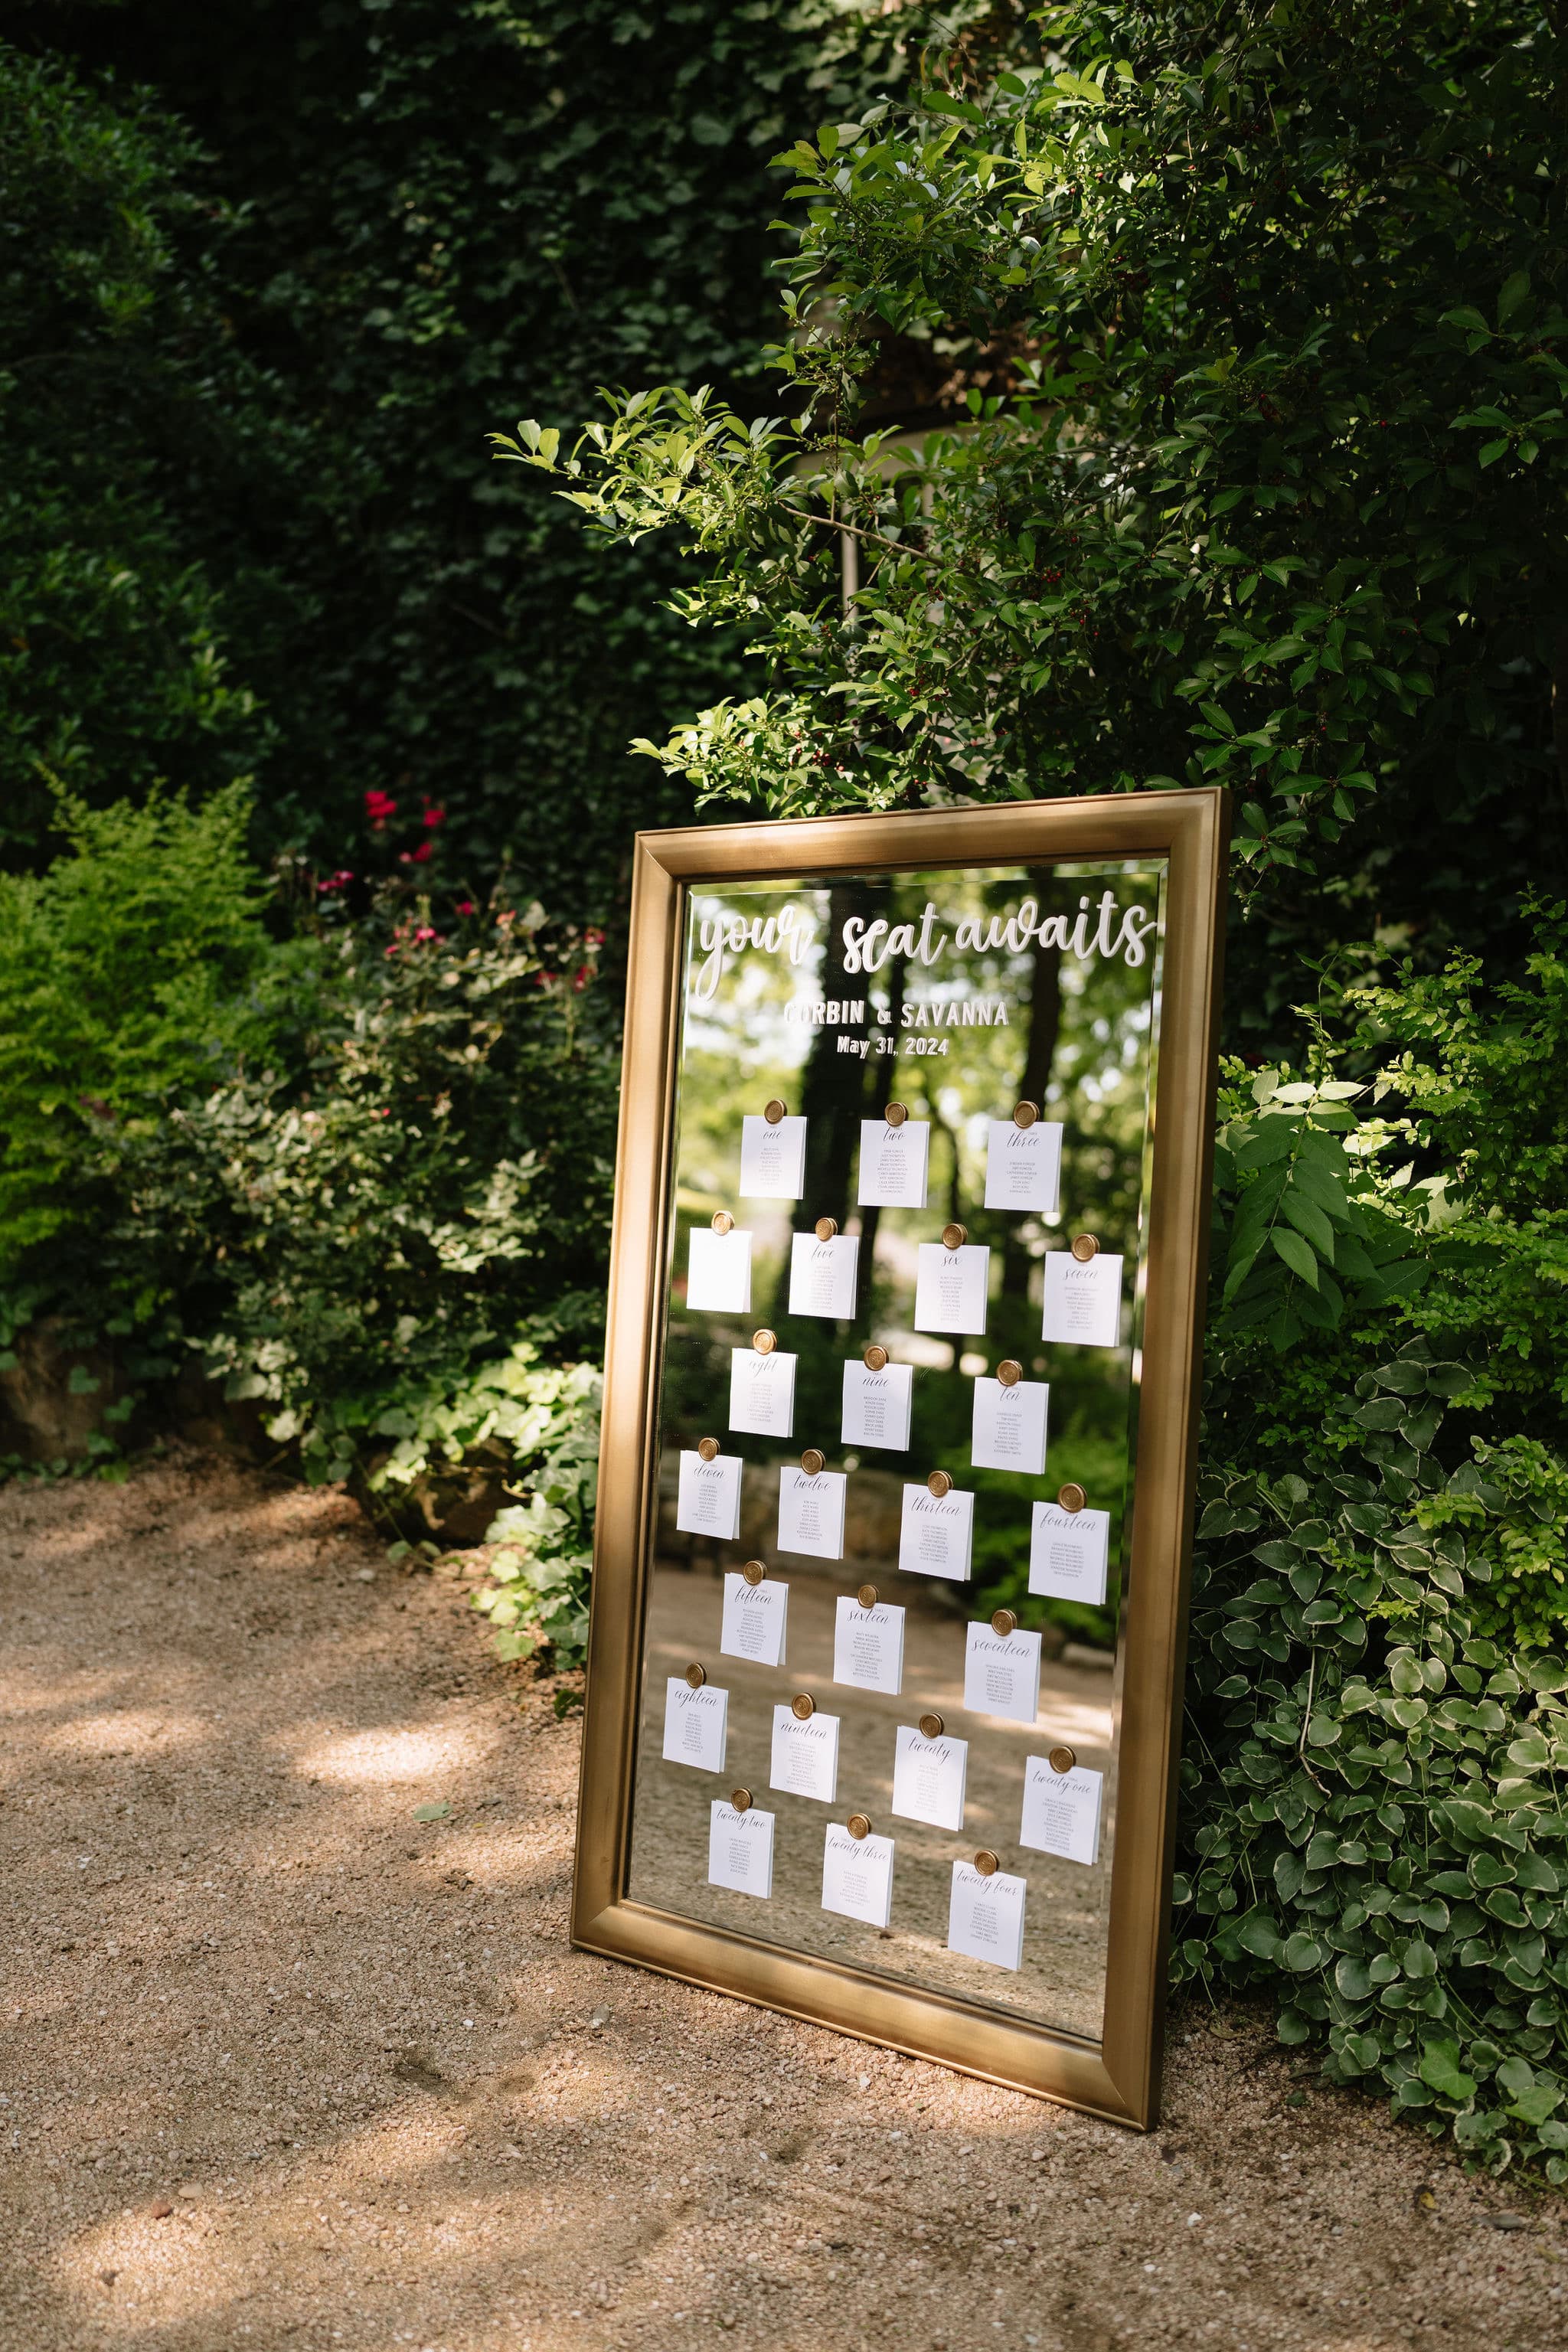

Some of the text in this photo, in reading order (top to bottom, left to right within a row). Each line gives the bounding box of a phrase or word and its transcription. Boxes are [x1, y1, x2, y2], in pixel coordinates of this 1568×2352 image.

[695, 890, 1158, 1003] your seat awaits
[877, 1008, 892, 1025] &
[900, 1001, 1009, 1027] SAVANNA
[836, 1035, 949, 1059] May 31, 2024
[883, 1127, 905, 1142] two
[1006, 1131, 1040, 1148] three
[942, 1254, 962, 1266] six
[862, 1377, 889, 1387] nine
[694, 1462, 724, 1478] eleven
[792, 1475, 831, 1490] twelve
[911, 1496, 962, 1516] thirteen
[1040, 1509, 1098, 1531] fourteen
[734, 1586, 773, 1606] fifteen
[847, 1609, 890, 1624] sixteen
[972, 1639, 1030, 1657] seventeen
[675, 1688, 717, 1707] eighteen
[779, 1722, 828, 1740] nineteen
[908, 1736, 951, 1764] twenty
